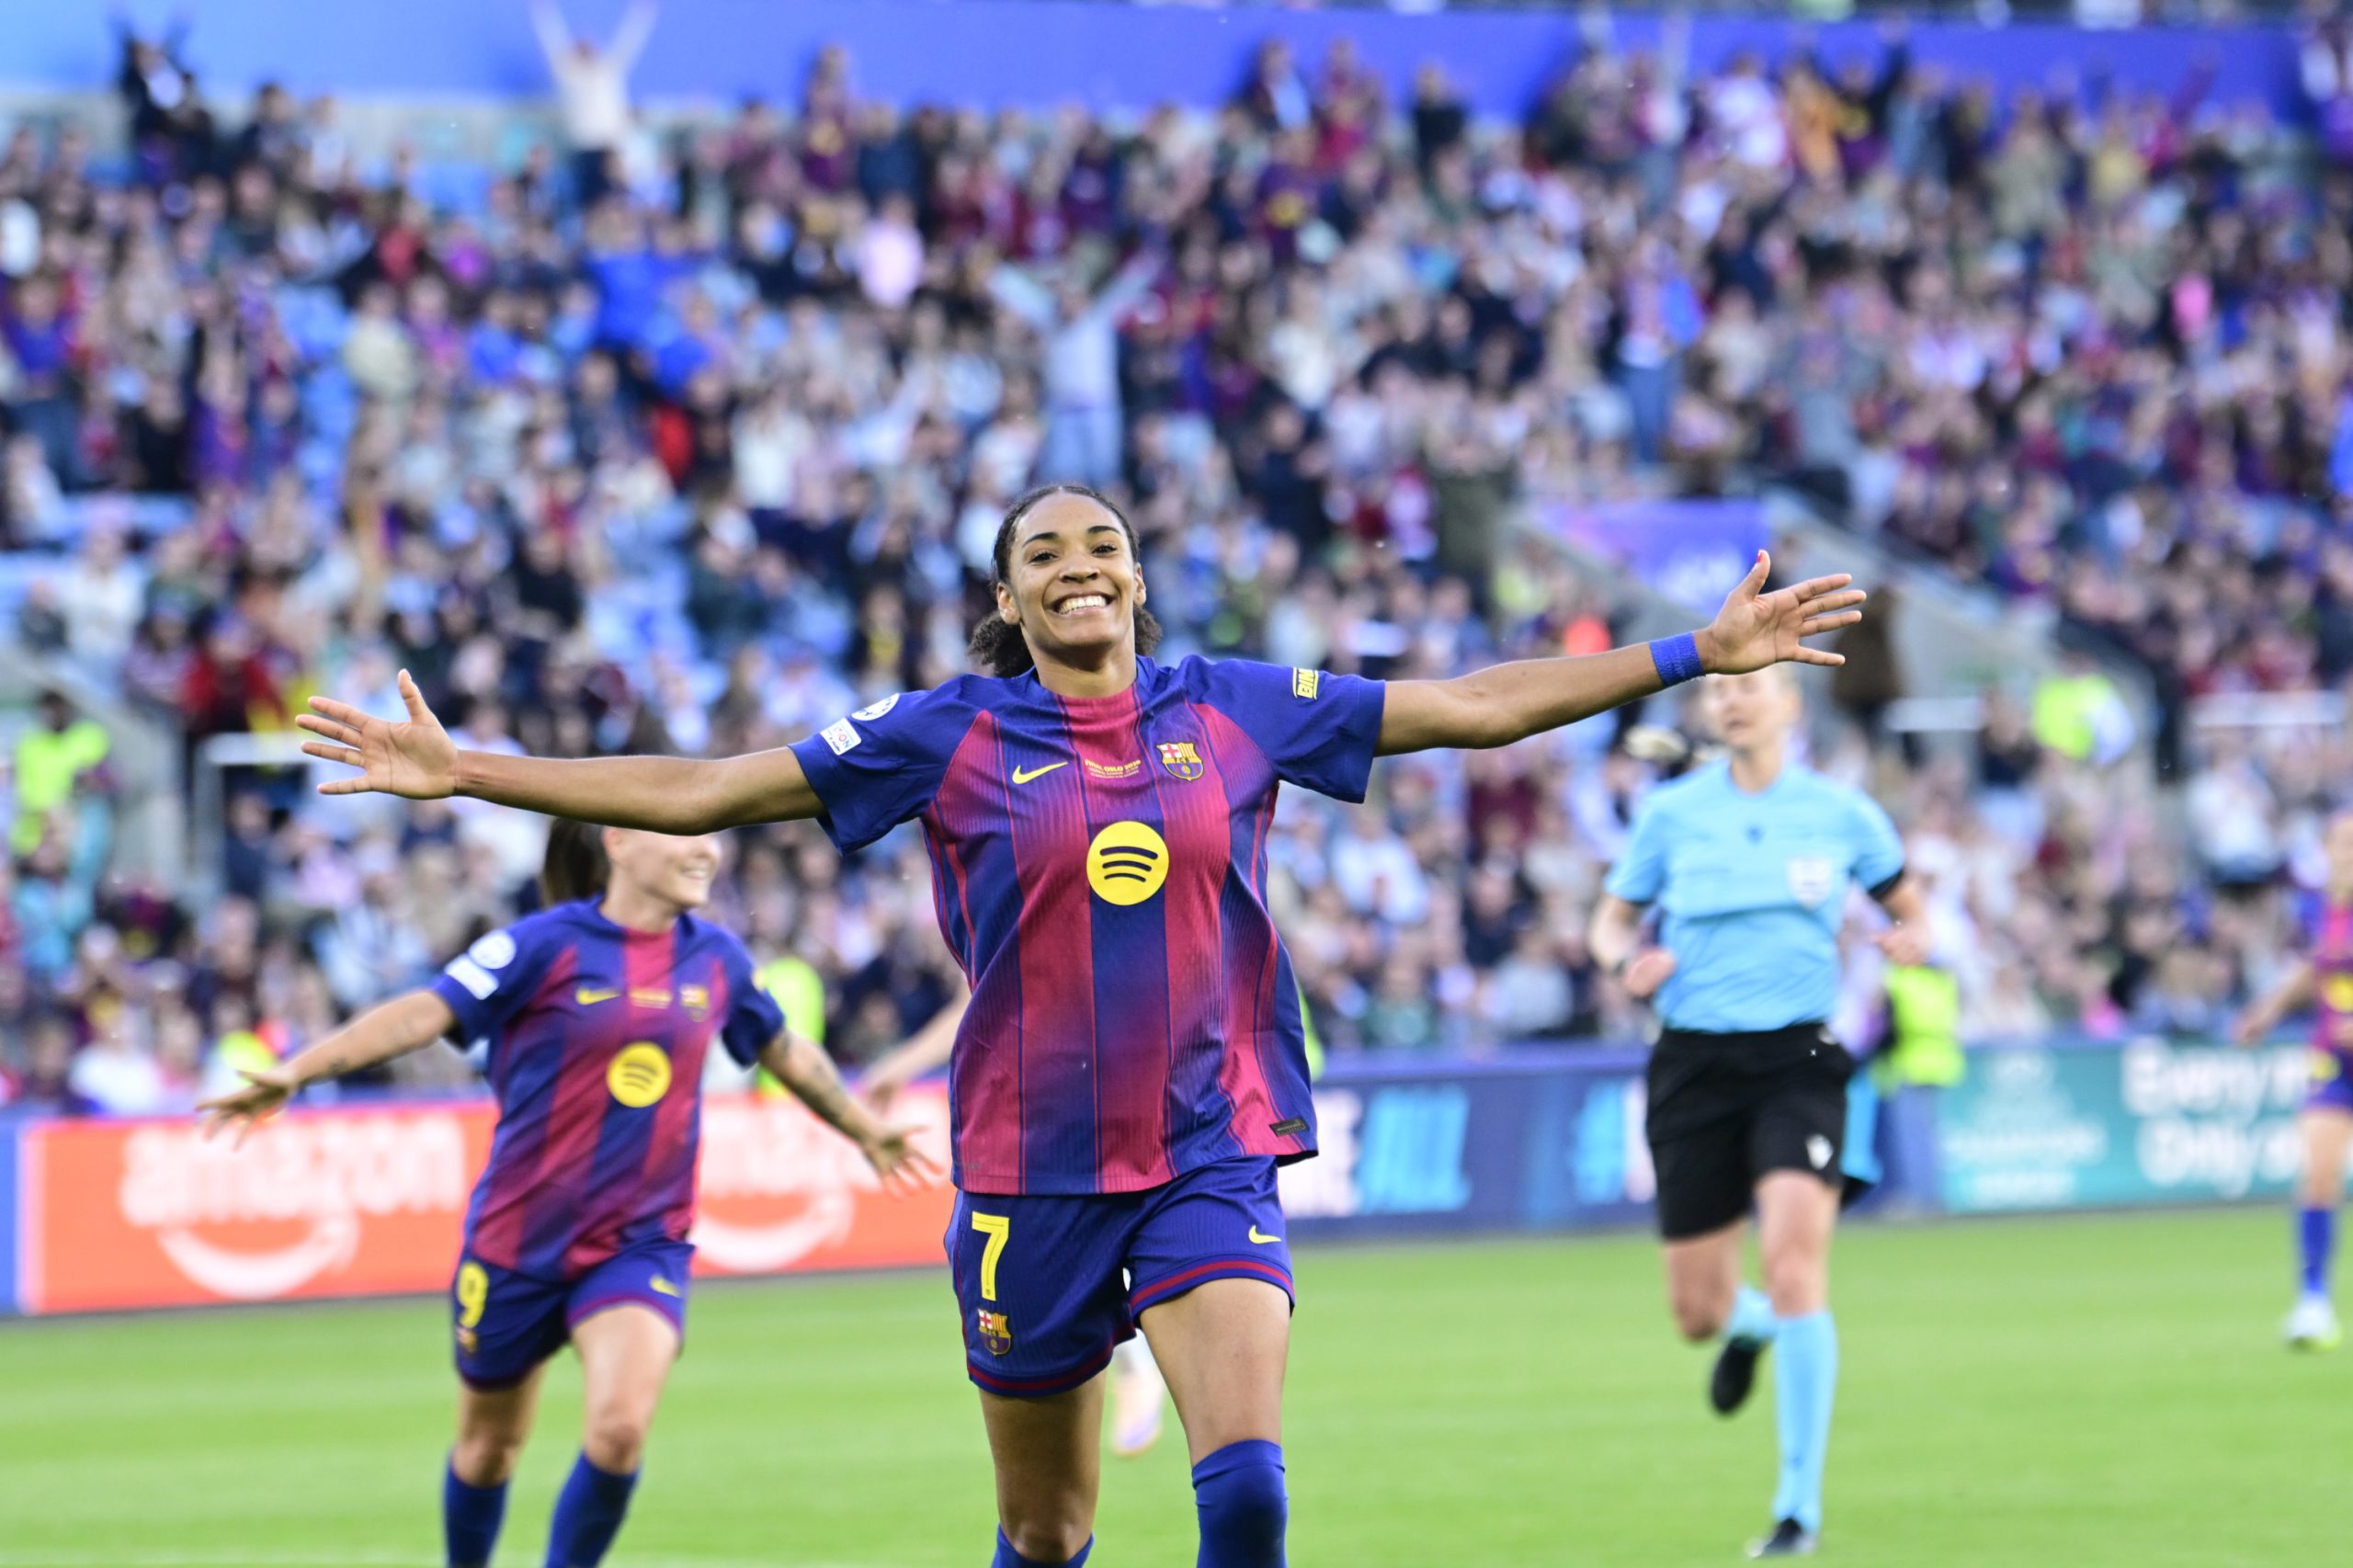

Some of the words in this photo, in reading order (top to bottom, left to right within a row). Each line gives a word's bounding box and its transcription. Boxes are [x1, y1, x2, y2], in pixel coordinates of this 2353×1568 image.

[121, 1115, 463, 1226] amazon
[458, 1261, 489, 1329] 9
[972, 1210, 1010, 1301] 7
